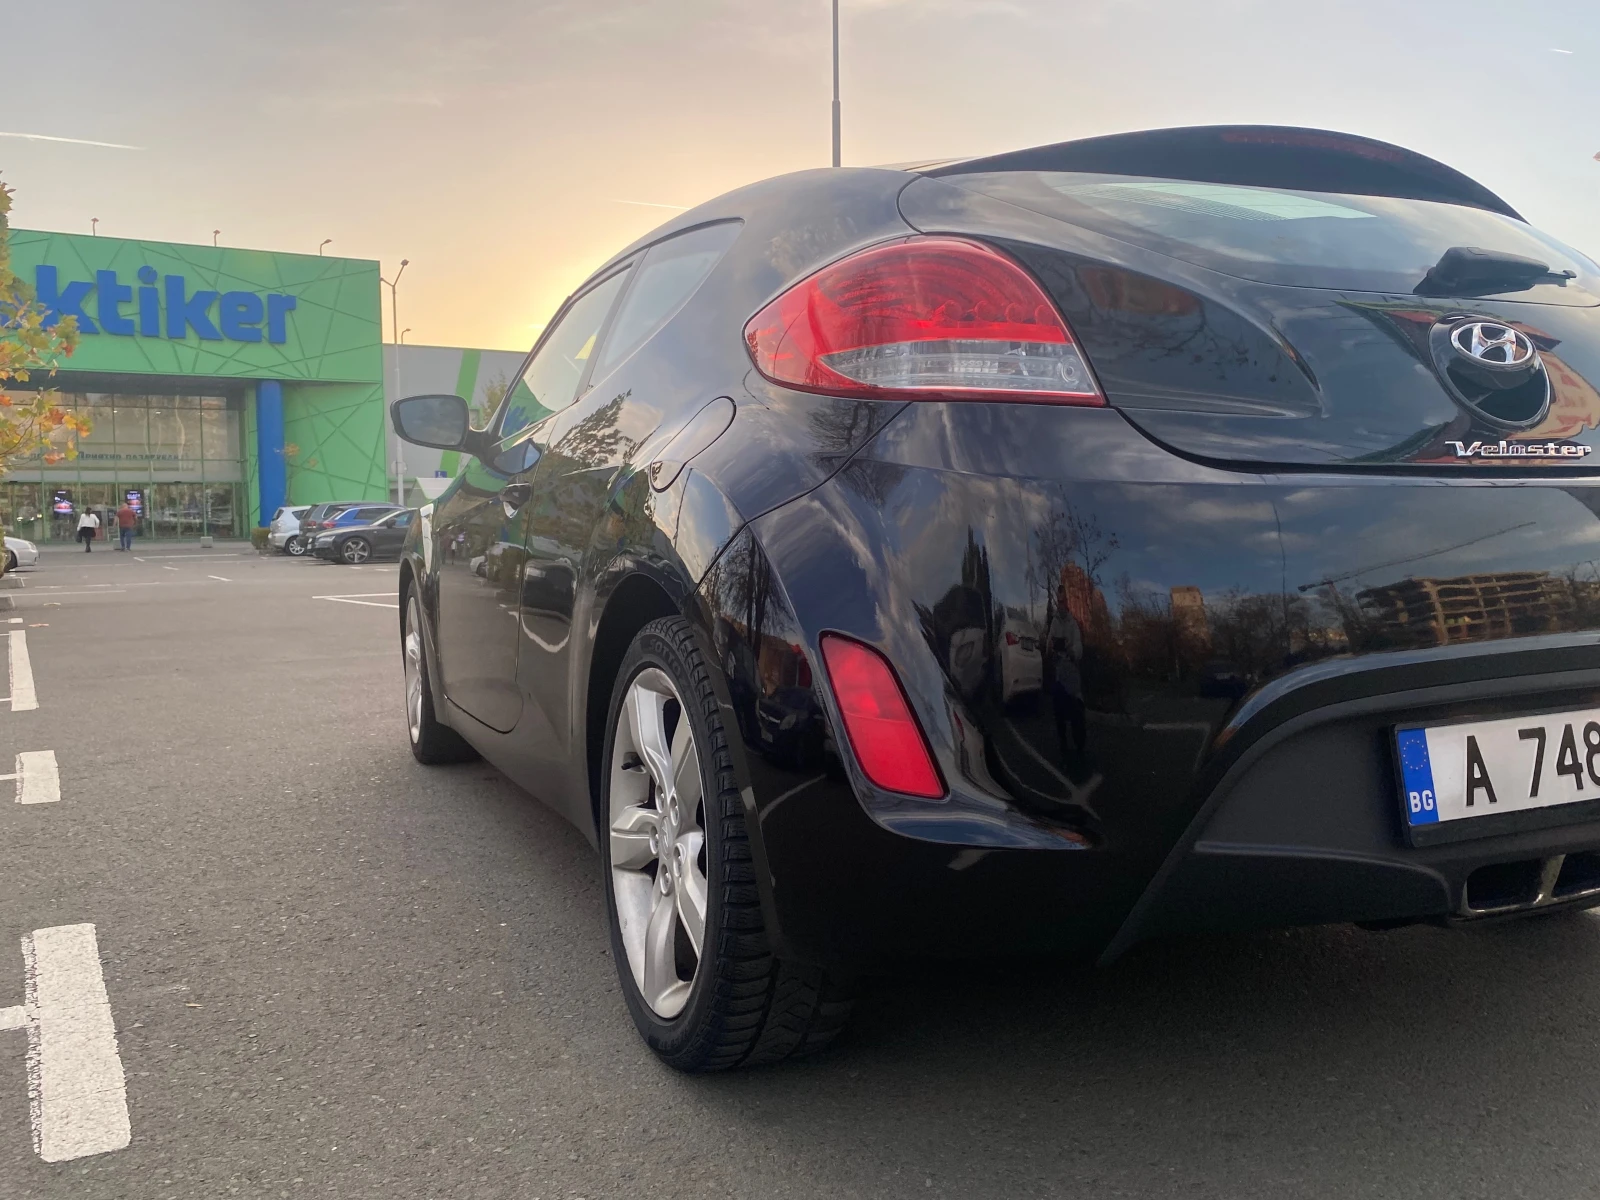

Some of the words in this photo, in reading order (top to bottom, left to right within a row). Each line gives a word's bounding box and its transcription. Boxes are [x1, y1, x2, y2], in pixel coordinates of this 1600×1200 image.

[0, 265, 297, 345] ktiker
[1445, 440, 1592, 457] Veloster
[1466, 735, 1497, 807] A
[1518, 721, 1600, 798] 748
[1409, 790, 1434, 813] BG
